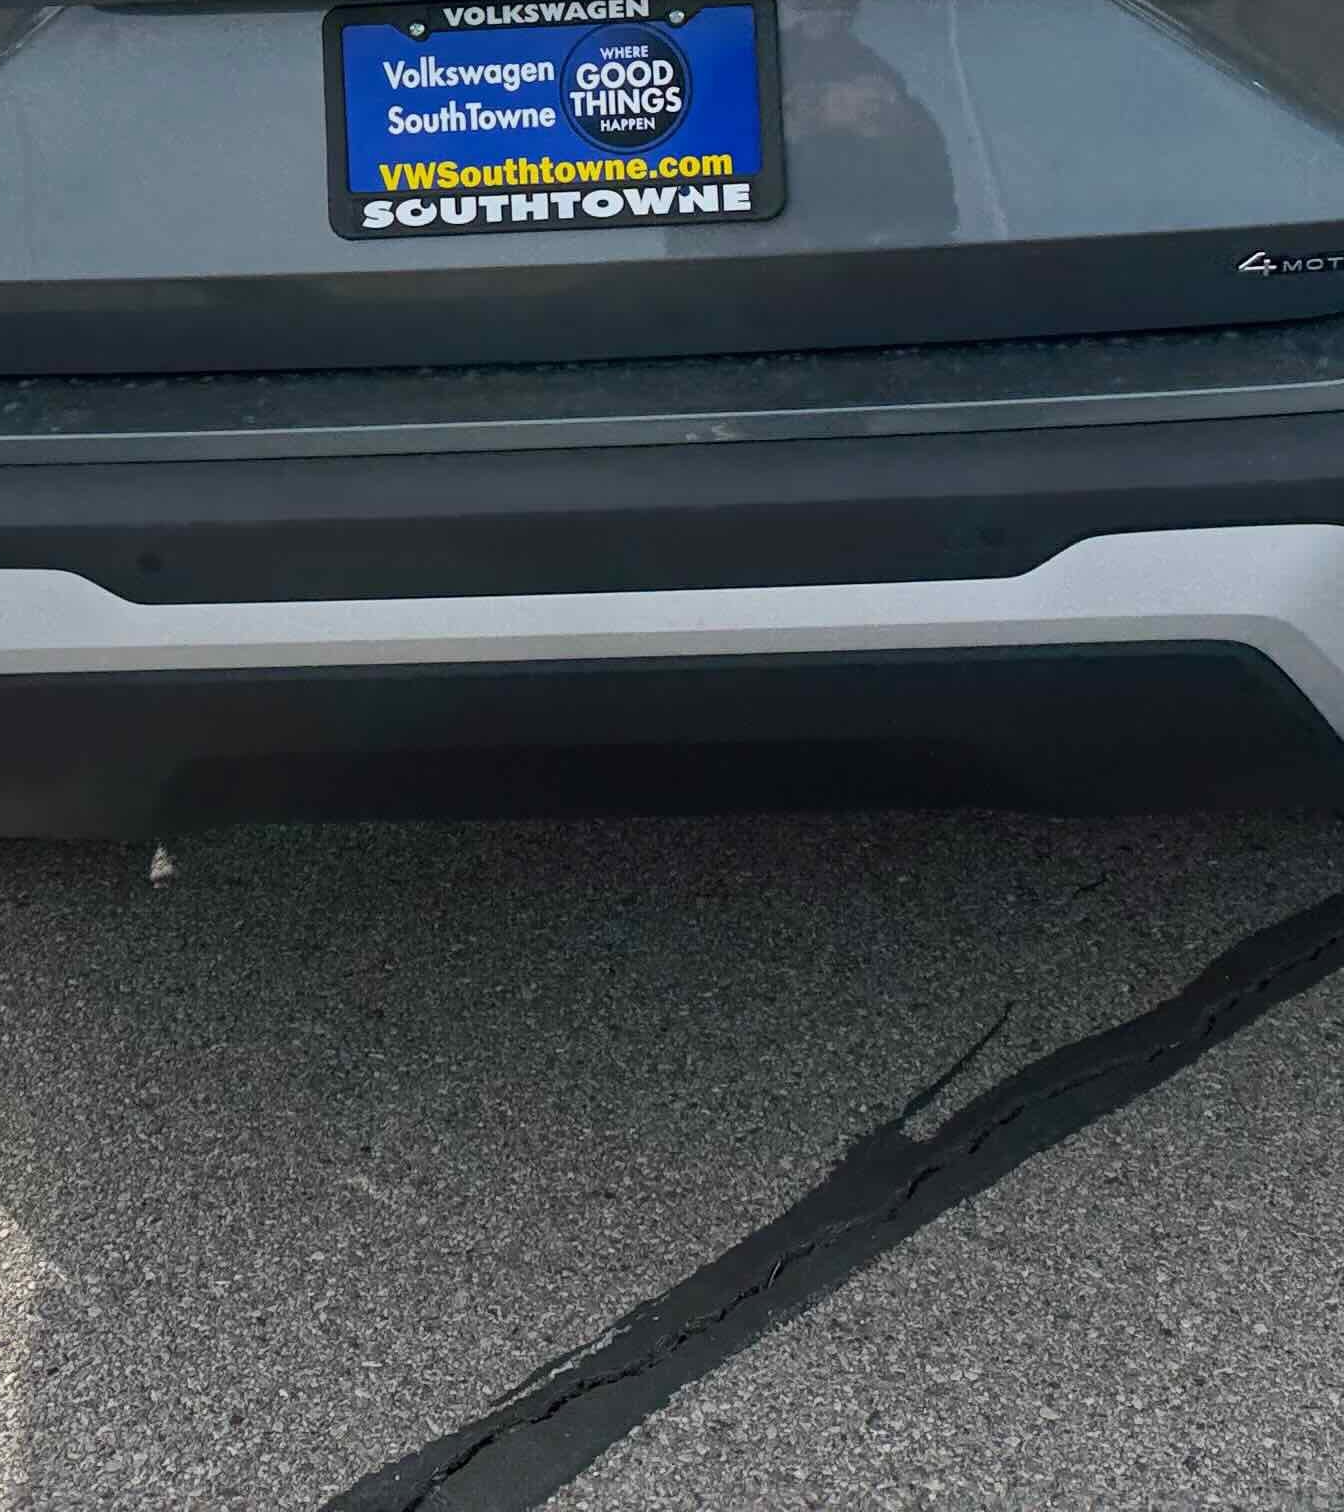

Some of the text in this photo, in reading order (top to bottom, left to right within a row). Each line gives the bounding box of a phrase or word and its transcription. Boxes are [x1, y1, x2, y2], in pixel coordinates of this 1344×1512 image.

[600, 45, 649, 60] WHERE
[383, 57, 555, 91] Volkswagen
[575, 60, 675, 90] GOOD
[569, 85, 682, 118] THINGS
[600, 117, 656, 133] HAPPEN
[379, 153, 733, 192] VWSouthtowne.com
[362, 183, 751, 229] SOUTHTOWNE
